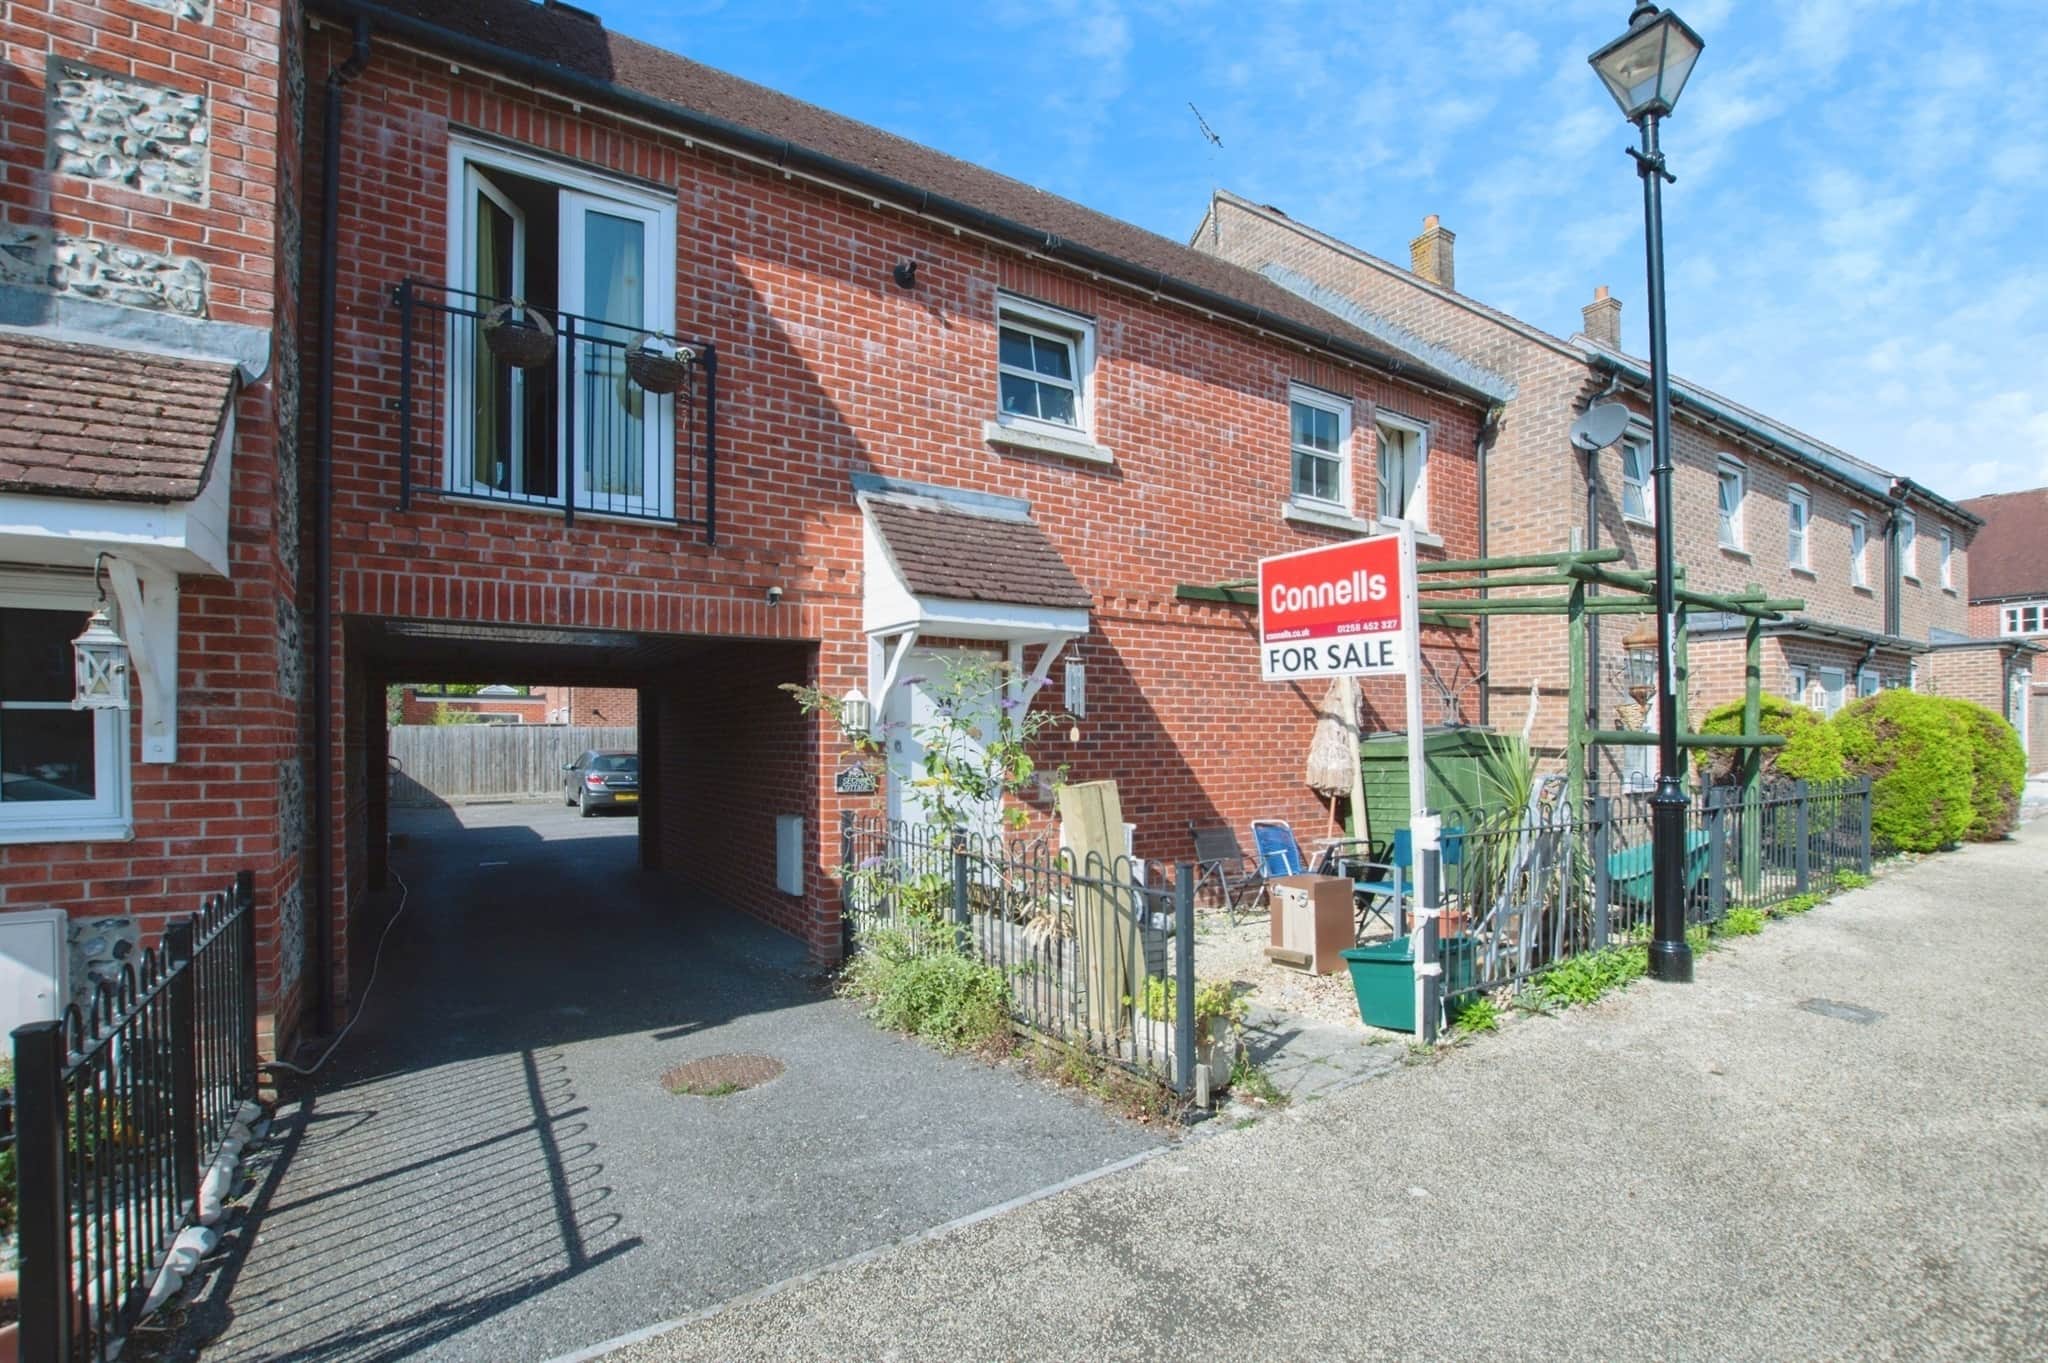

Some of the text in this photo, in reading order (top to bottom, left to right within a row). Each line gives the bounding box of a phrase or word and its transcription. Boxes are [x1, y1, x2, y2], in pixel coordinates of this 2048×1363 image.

[1271, 570, 1387, 614] Connells
[1362, 621, 1378, 631] 452
[1381, 619, 1398, 629] 327
[1269, 640, 1394, 673] FOR SALE
